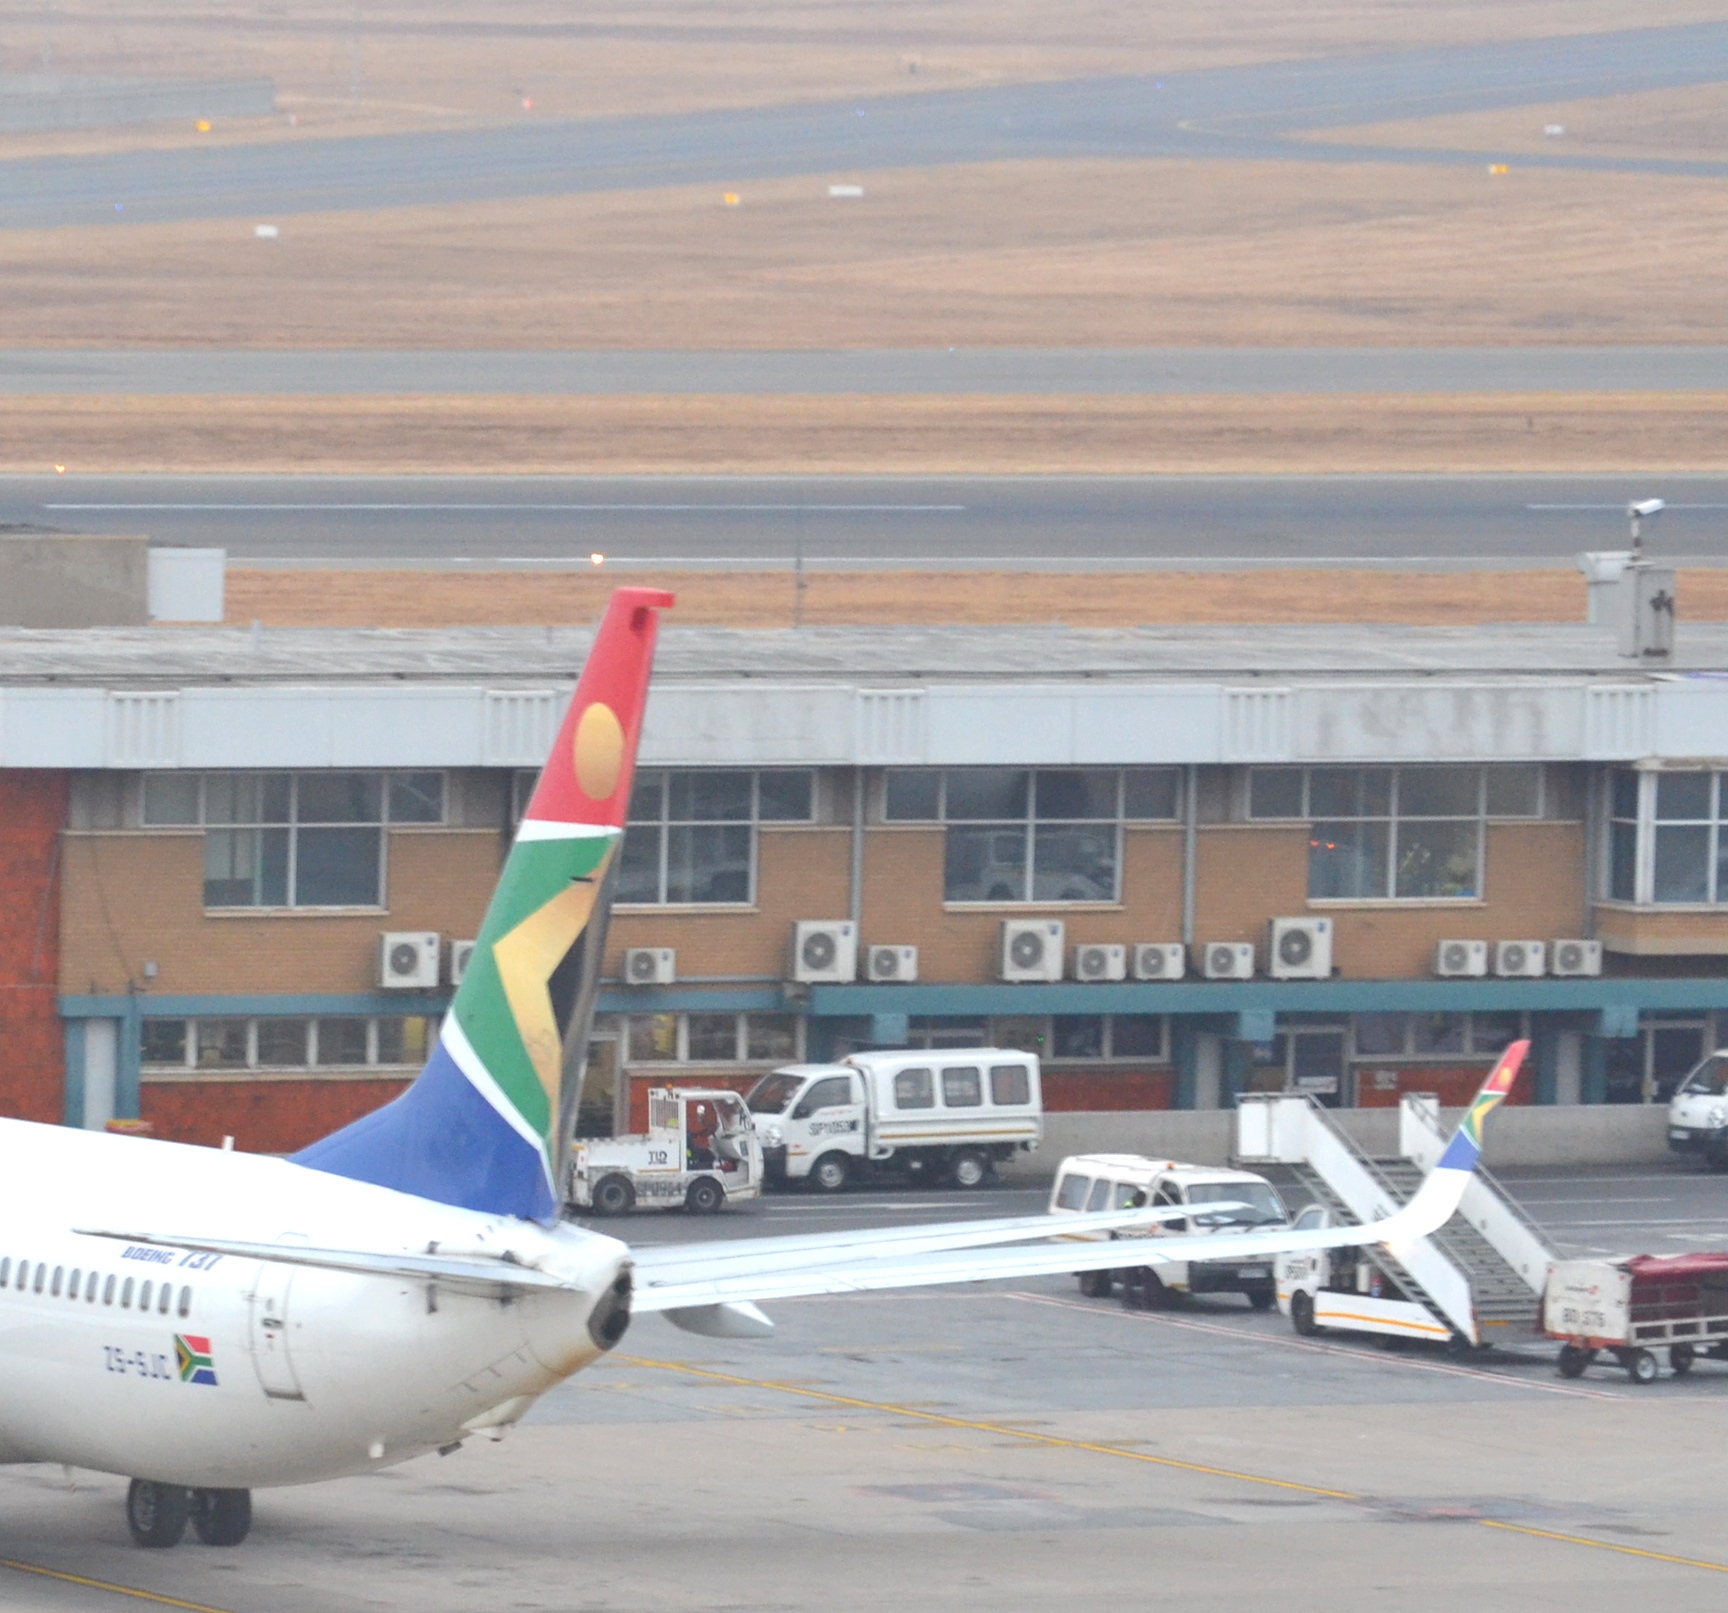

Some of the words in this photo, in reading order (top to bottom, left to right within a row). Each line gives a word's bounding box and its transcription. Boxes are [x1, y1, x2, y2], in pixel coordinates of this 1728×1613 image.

[121, 1246, 175, 1265] BOEING
[178, 1250, 223, 1271] 737
[104, 1345, 171, 1380] ZS-SJC
